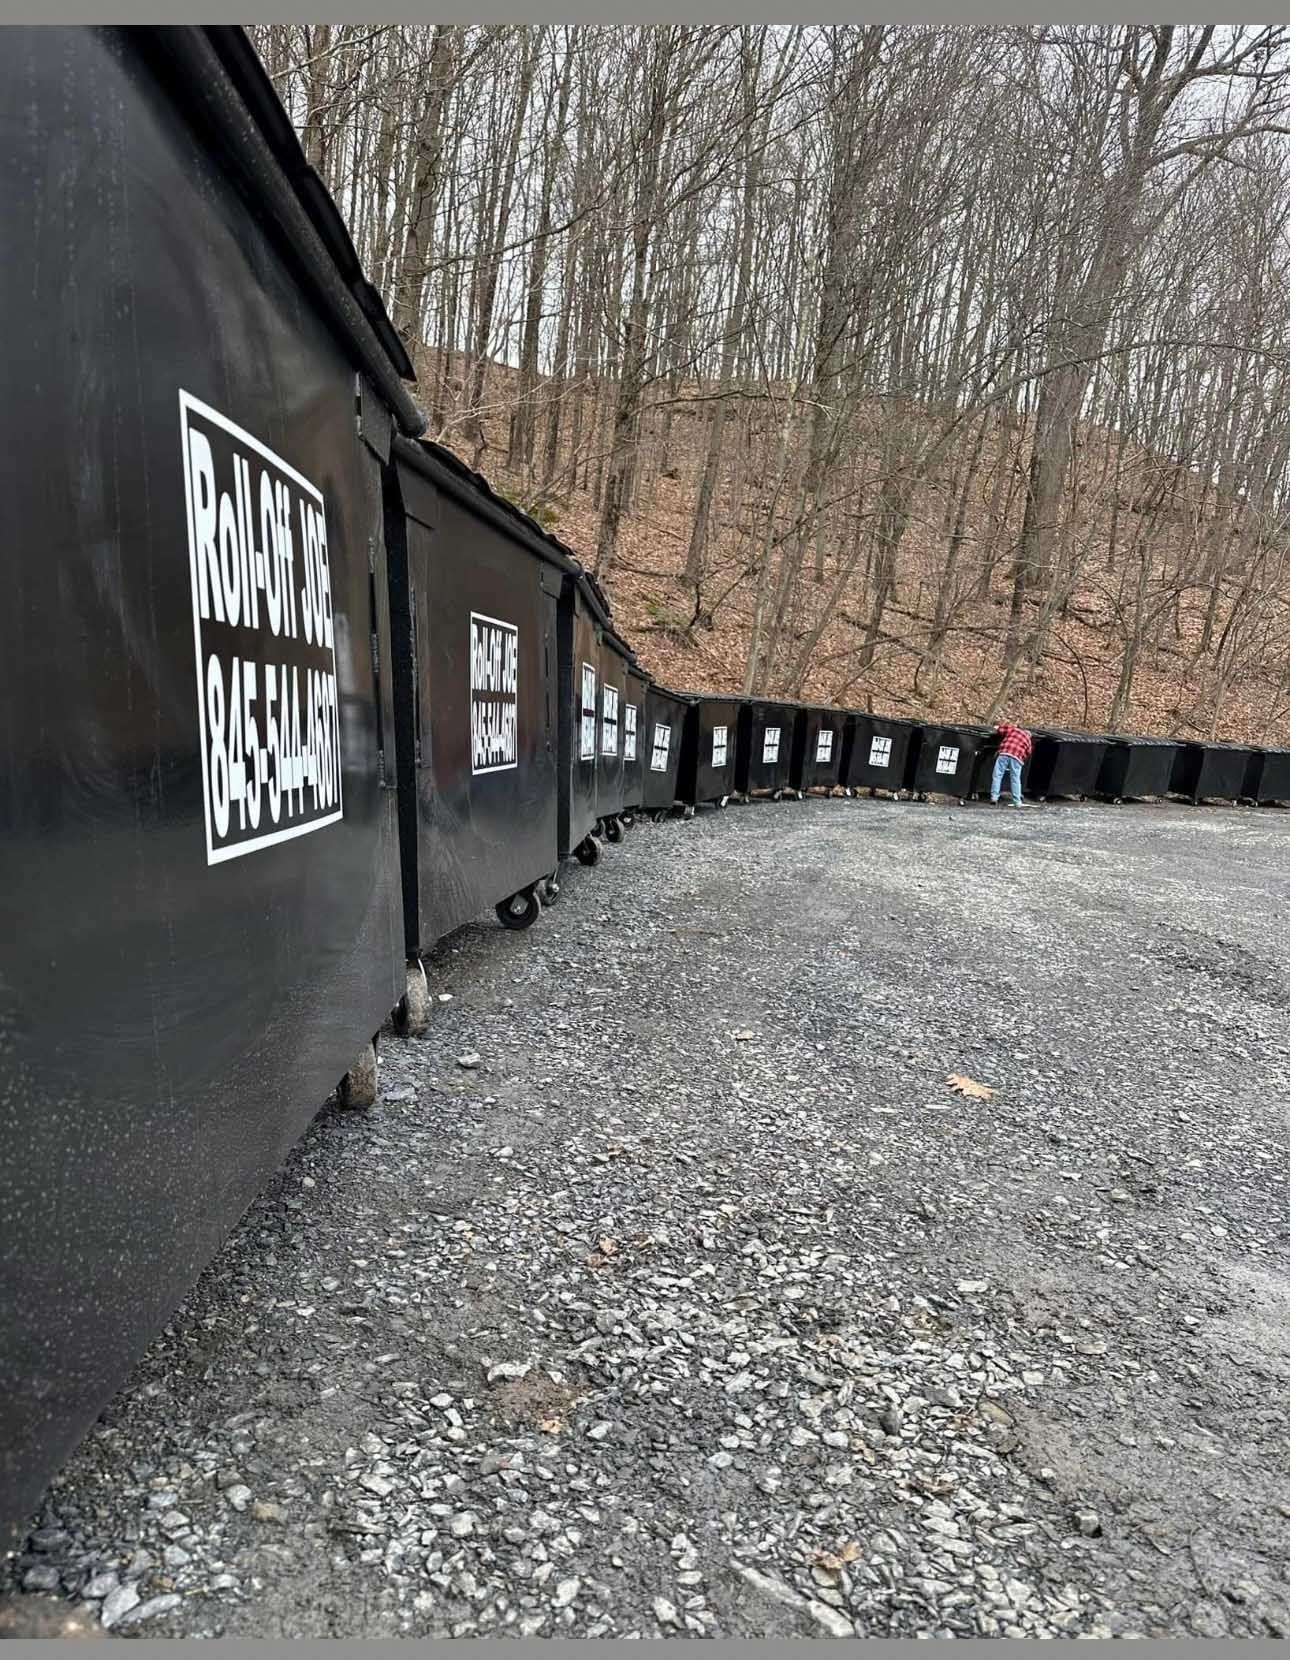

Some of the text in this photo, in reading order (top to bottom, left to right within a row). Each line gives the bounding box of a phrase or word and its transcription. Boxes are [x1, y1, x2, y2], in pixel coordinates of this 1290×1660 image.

[188, 427, 333, 649] Roll-Off JOE
[207, 653, 338, 839] 845-544-4687
[472, 623, 503, 692] Roll-Off
[502, 633, 517, 694] JOE
